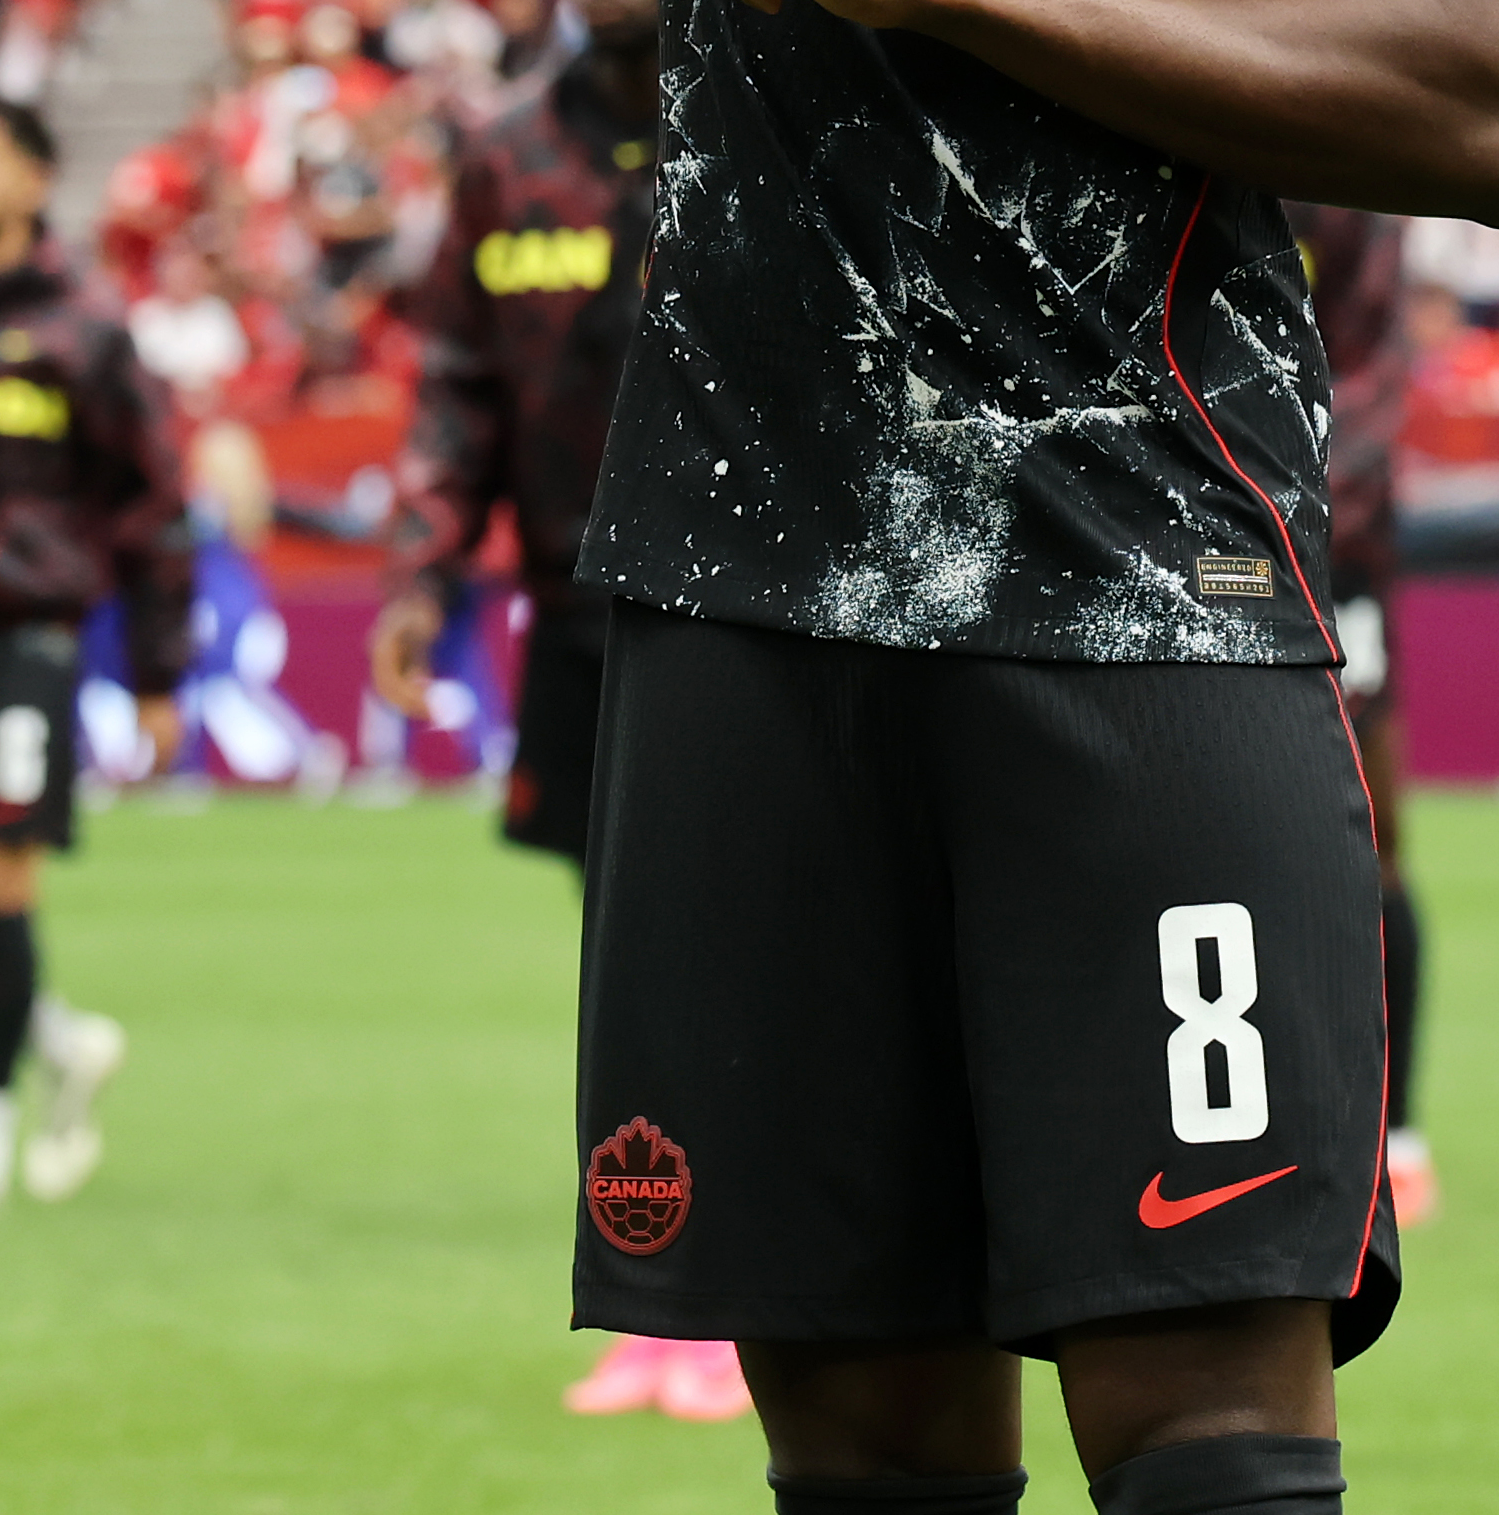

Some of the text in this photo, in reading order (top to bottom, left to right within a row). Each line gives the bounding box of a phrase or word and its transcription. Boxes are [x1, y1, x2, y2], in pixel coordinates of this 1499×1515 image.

[474, 226, 613, 297] CAN
[1157, 902, 1271, 1144] 8
[592, 1180, 684, 1199] CANADA
